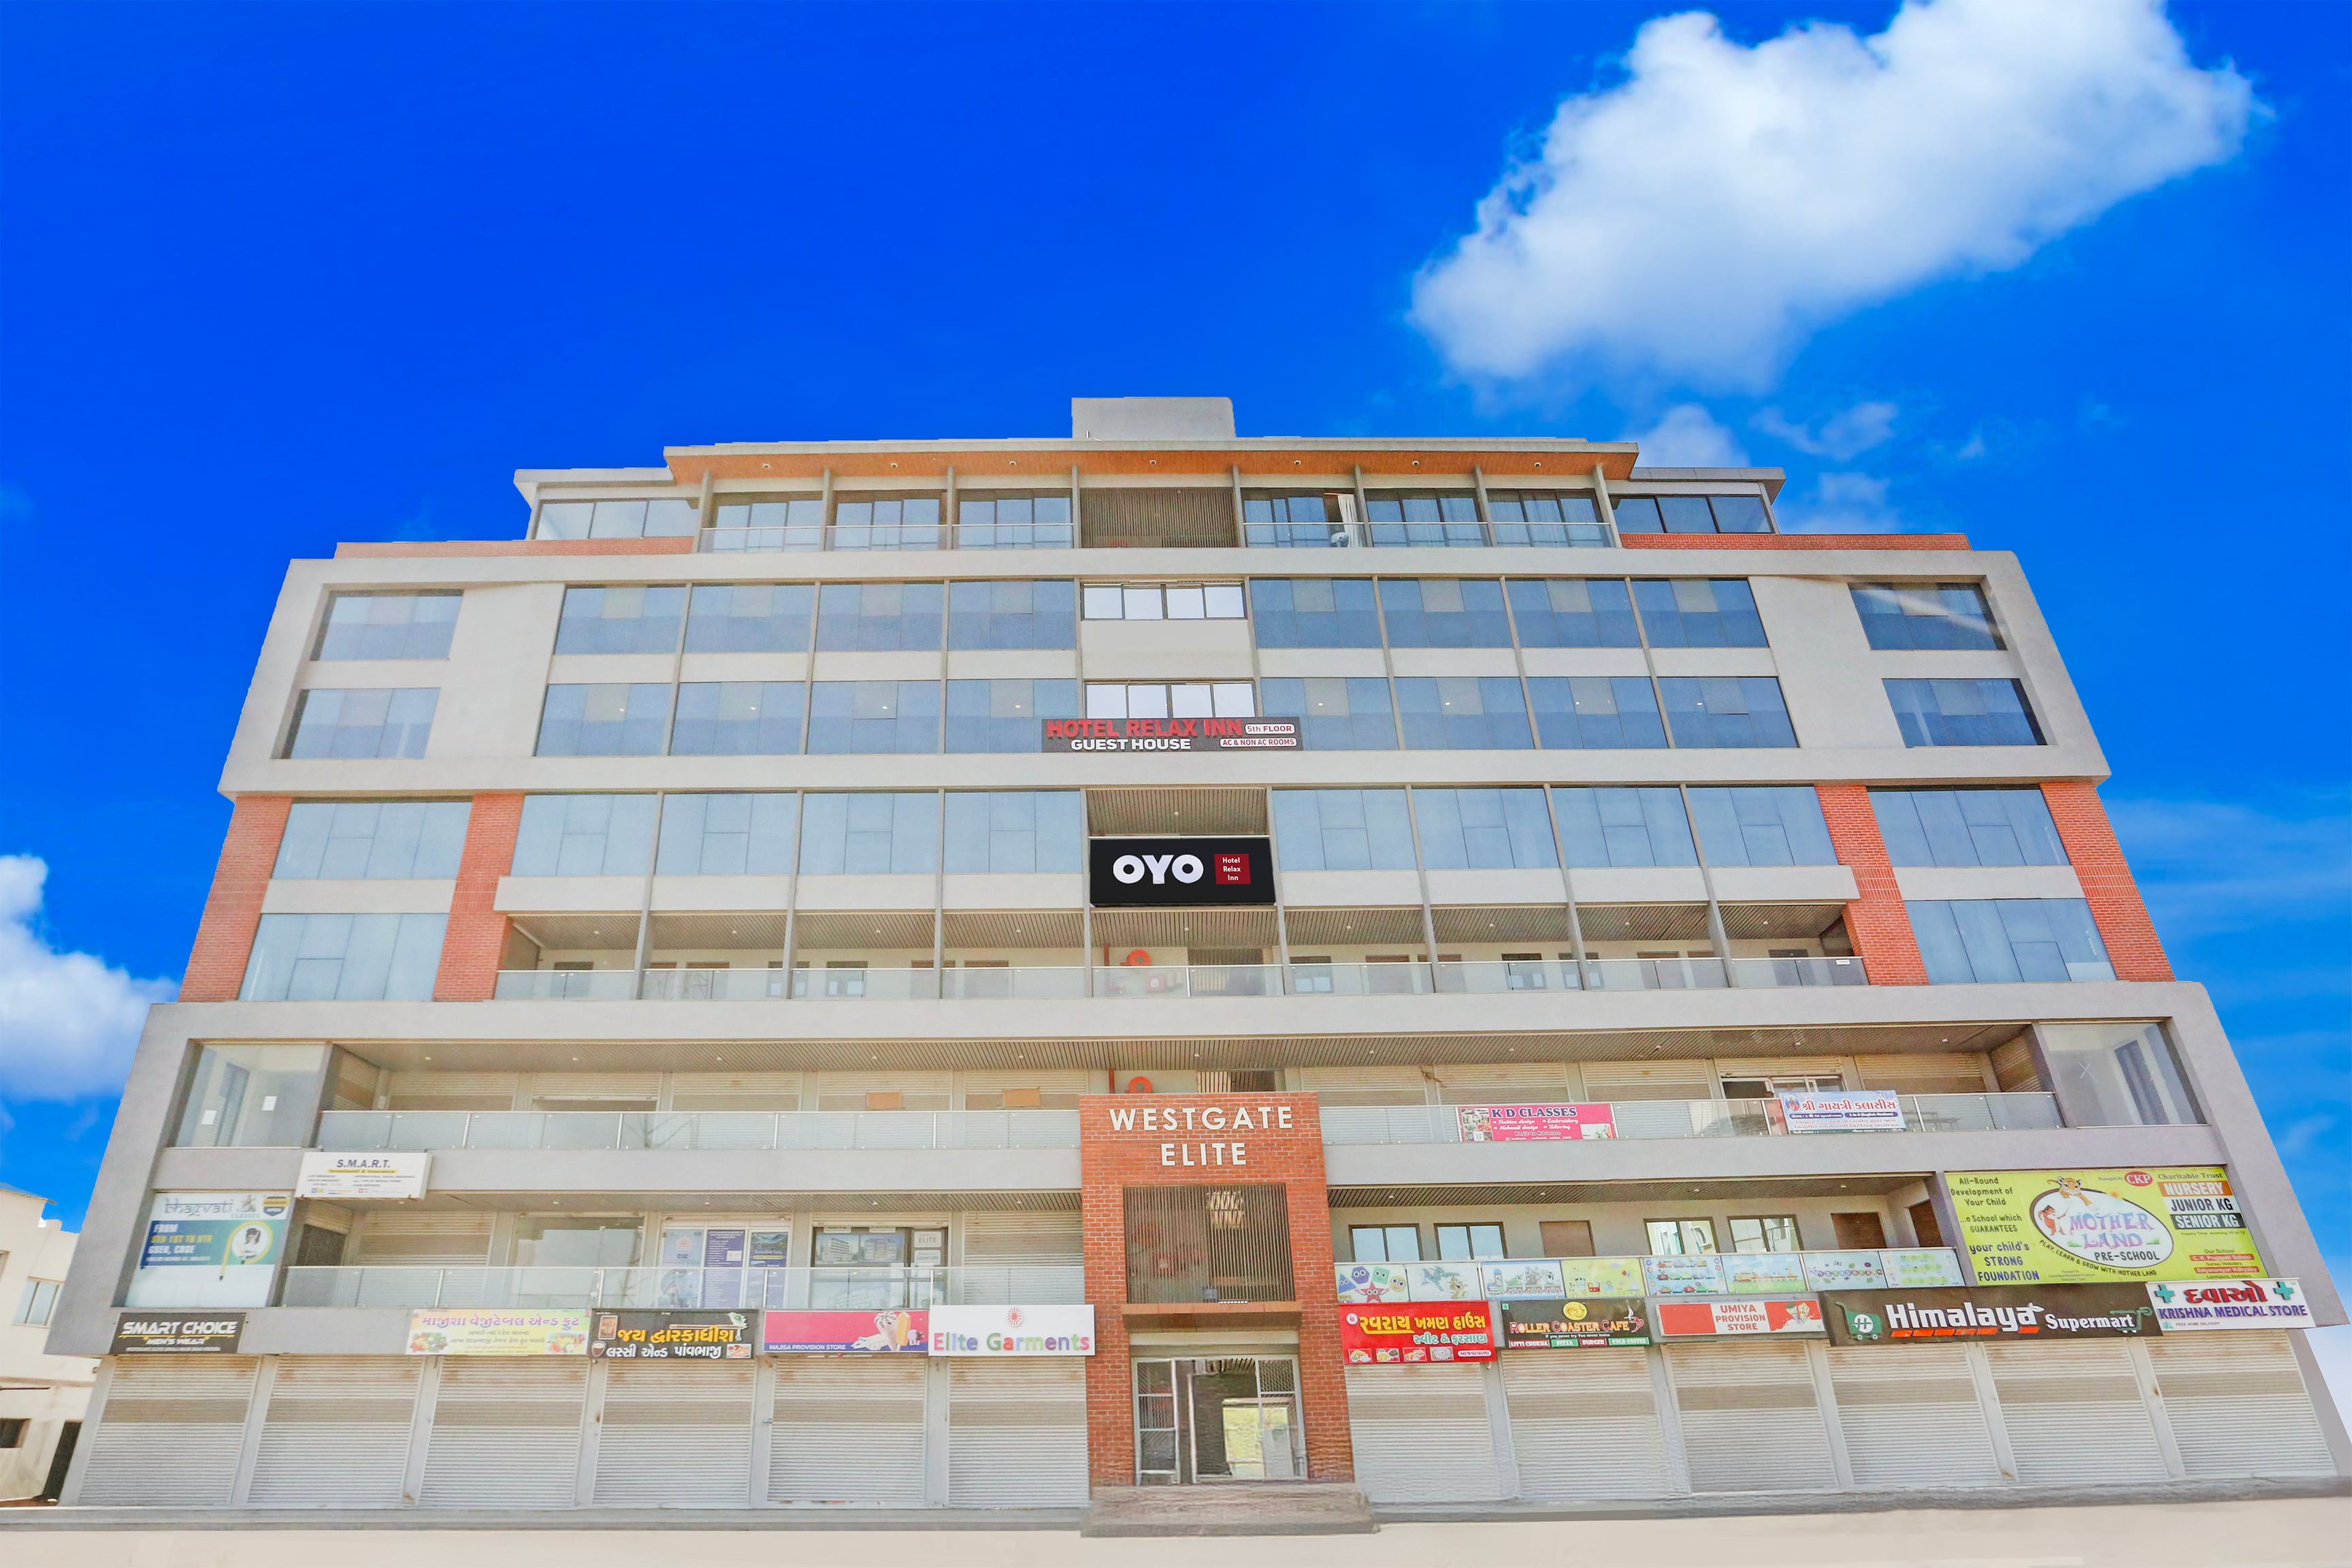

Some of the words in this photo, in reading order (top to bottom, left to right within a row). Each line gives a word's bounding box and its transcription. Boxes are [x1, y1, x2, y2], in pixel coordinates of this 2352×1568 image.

[1047, 719, 1120, 738] HOTEL
[1126, 719, 1198, 737] RELAX
[1204, 719, 1243, 737] INN
[1071, 738, 1128, 751] GUEST
[1131, 738, 1191, 750] HOUSE
[1113, 854, 1204, 884] OYO
[1109, 1107, 1292, 1131] WESTGATE
[1491, 1109, 1502, 1118] K
[1506, 1109, 1516, 1118] D
[1519, 1107, 1578, 1117] CLASSES
[1161, 1143, 1247, 1166] ELITE
[337, 1160, 391, 1168] S.M.A.R.T.
[1959, 1177, 1999, 1185] All-Round
[2126, 1175, 2151, 1184] CKP
[1950, 1188, 2002, 1196] Development
[2165, 1183, 2225, 1196] NURSERY
[165, 1198, 233, 1217] bhagvati
[2171, 1199, 2213, 1212] JUNIOR
[2217, 1198, 2234, 1211] KG
[1999, 1214, 2022, 1222] which
[2070, 1212, 2155, 1234] MOTHER
[2177, 1215, 2219, 1228] SENIOR
[2223, 1214, 2240, 1227] KG
[1970, 1245, 1993, 1254] your
[1997, 1241, 2029, 1251] child's
[2082, 1232, 2143, 1250] LAND
[1984, 1256, 2023, 1267] STRONG
[2055, 1250, 2075, 1262] LEARN
[2082, 1261, 2099, 1271] GROW
[2101, 1267, 2116, 1275] WITH
[2094, 1251, 2160, 1261] PRE-SCHOOL
[1978, 1271, 2040, 1281] FOUNDATION
[2183, 1280, 2268, 1304] દવાઓ
[1720, 1304, 1757, 1313] UMIYA
[2158, 1306, 2212, 1319] KRISHNA
[2214, 1305, 2268, 1318] MEDICAL
[2269, 1305, 2308, 1316] STORE
[1359, 1316, 1414, 1333] રવરાય
[1414, 1316, 1449, 1329] ખમણ
[1453, 1311, 1486, 1330] હાઉસ
[1715, 1314, 1766, 1323] PROVISION
[1885, 1302, 2039, 1333] Himalaya
[2045, 1313, 2136, 1332] Supermart
[121, 1322, 182, 1335] SMART
[182, 1321, 238, 1334] CHOICE
[1509, 1322, 1551, 1333] ROLLER
[1552, 1321, 1600, 1333] COASTER
[1601, 1320, 1630, 1331] CAFE
[1727, 1323, 1758, 1331] STORE
[617, 1329, 647, 1341] જય
[651, 1326, 735, 1343] દ્વારકાધીશ
[1441, 1333, 1451, 1344] &
[934, 1332, 978, 1352] Elite
[986, 1332, 1090, 1352] Garments
[606, 1343, 636, 1358] લસ્સી
[641, 1344, 668, 1358] એન્ડ
